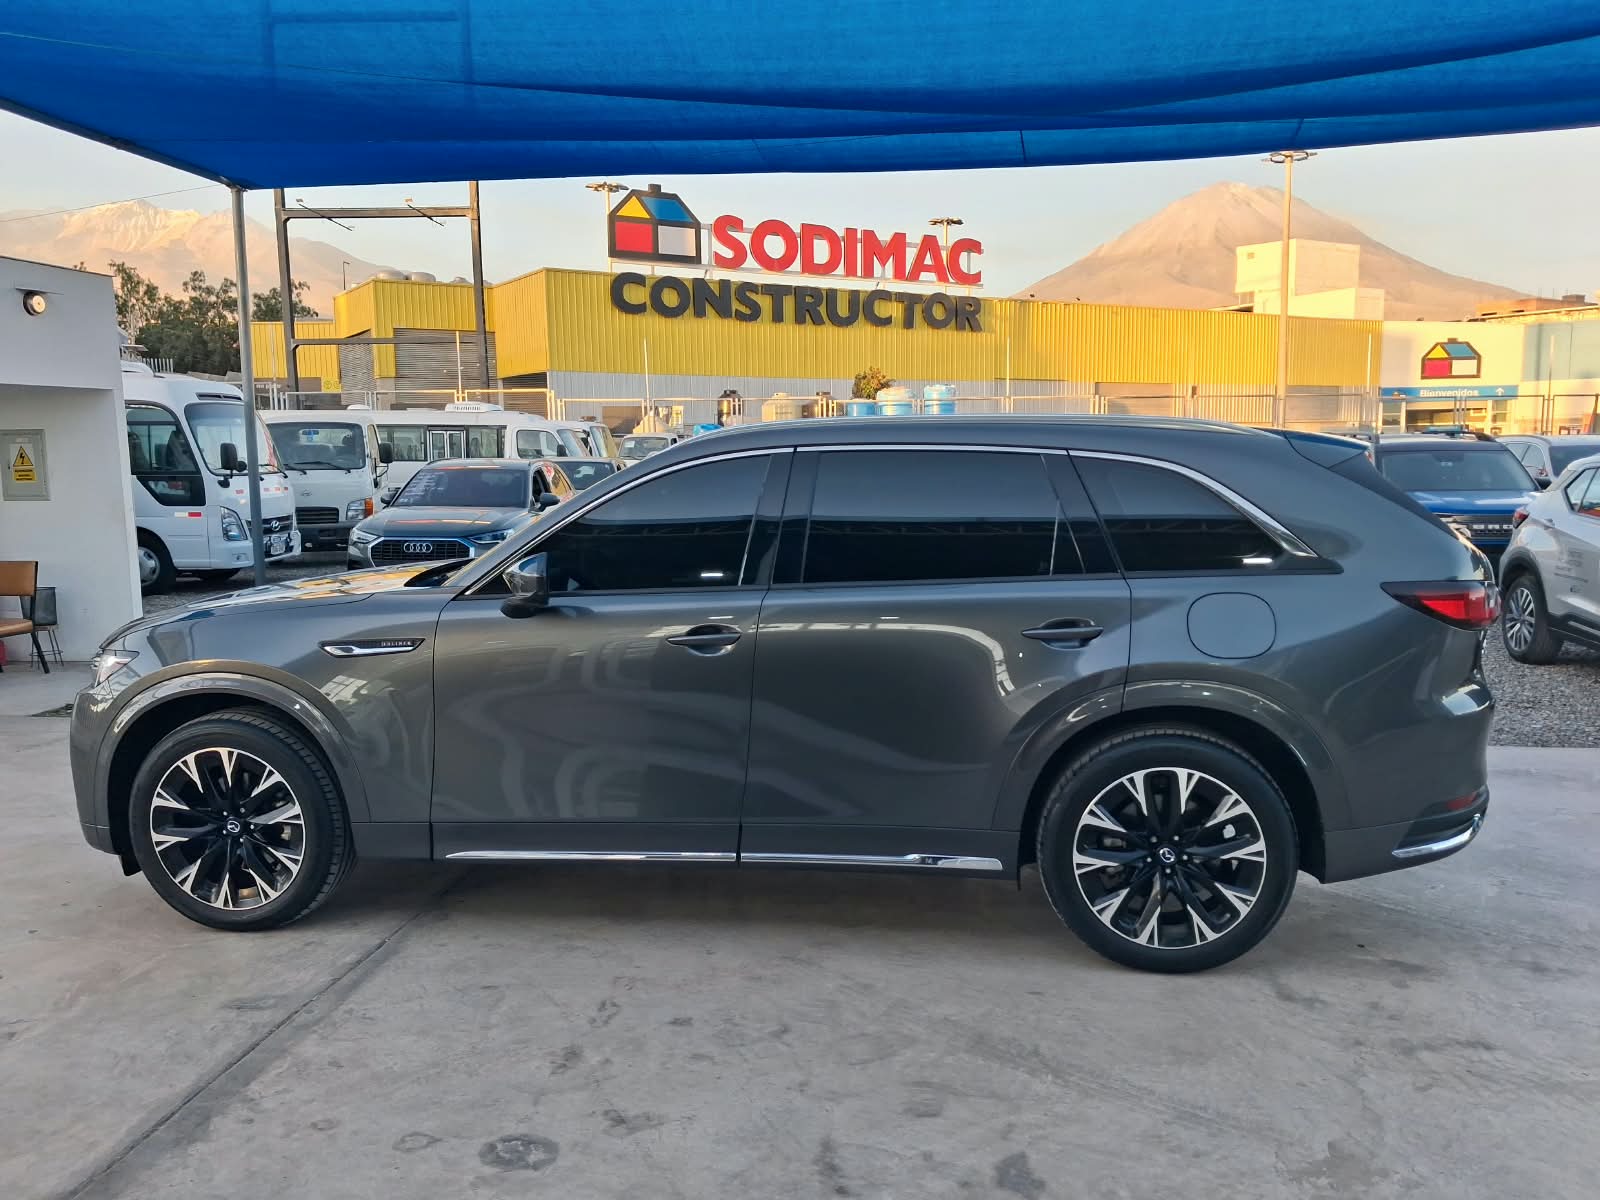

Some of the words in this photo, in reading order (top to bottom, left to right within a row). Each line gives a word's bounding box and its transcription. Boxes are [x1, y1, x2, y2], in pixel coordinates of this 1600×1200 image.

[712, 214, 982, 284] SODIMAC
[610, 272, 982, 332] CONSTRUCTOR
[1419, 388, 1480, 397] Bienvenidos
